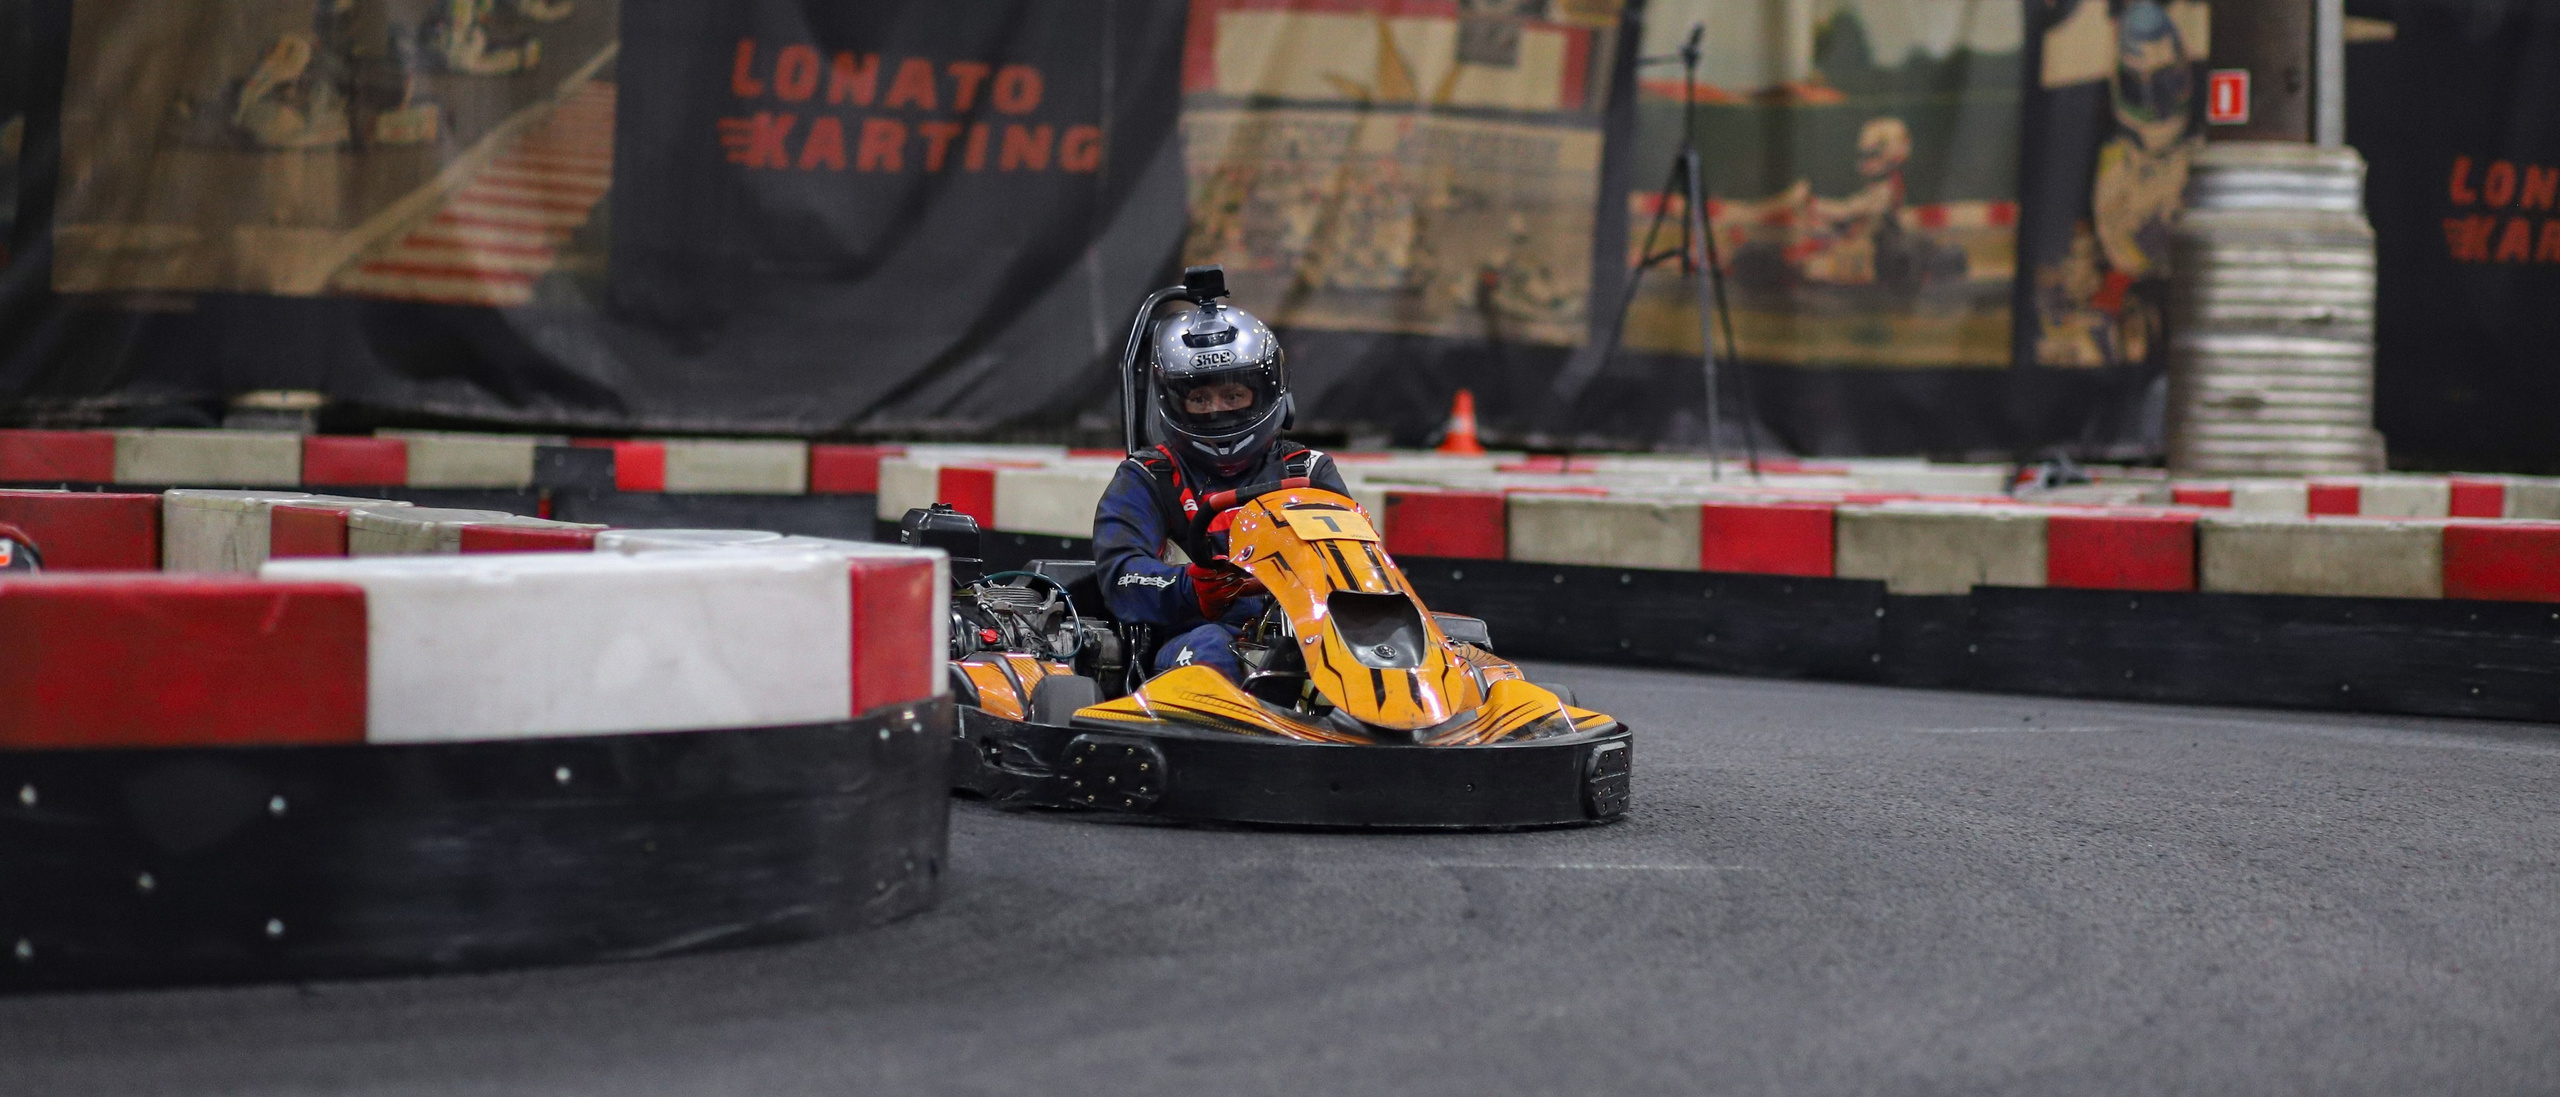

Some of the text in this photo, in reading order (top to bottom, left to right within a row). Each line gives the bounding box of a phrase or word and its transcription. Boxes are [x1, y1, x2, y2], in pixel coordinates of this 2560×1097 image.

[731, 38, 1045, 115] LONATO
[742, 112, 1101, 172] KARTING
[2450, 155, 2560, 210] LON
[1196, 352, 1231, 367] SHOEI
[1312, 516, 1342, 533] 1
